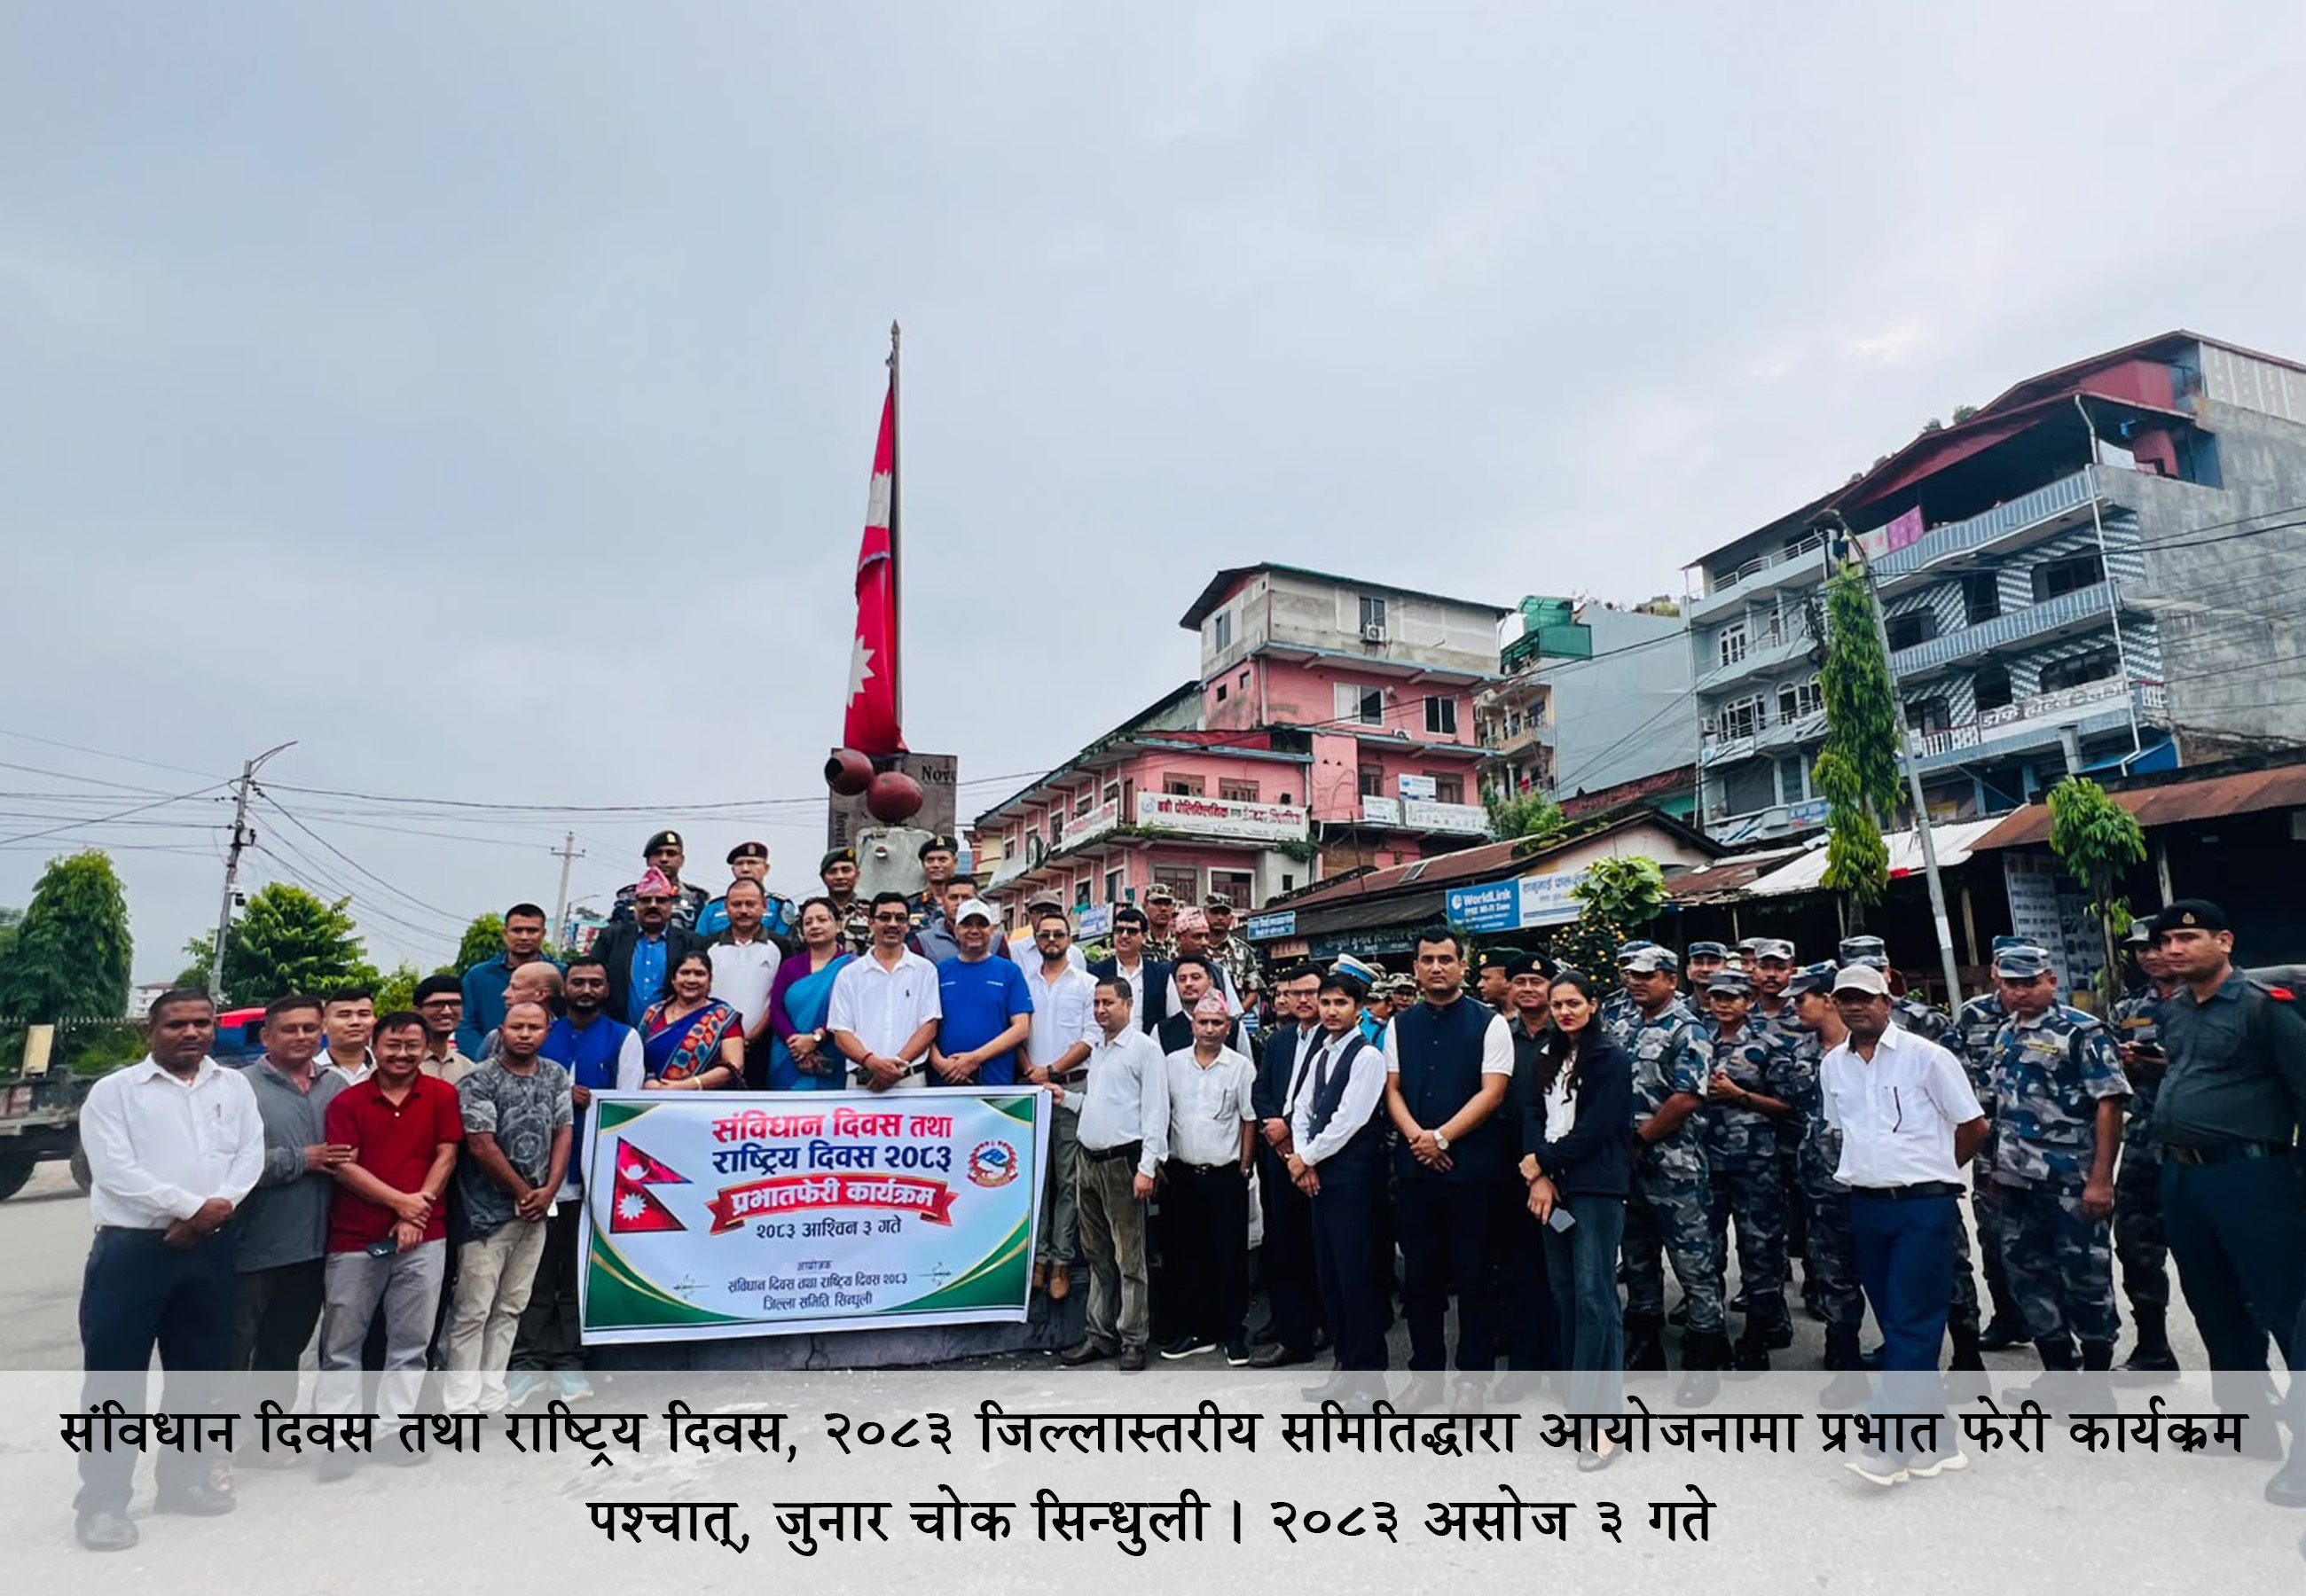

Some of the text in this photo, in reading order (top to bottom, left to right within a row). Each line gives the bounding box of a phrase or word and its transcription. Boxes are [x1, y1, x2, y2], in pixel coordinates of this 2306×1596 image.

[1463, 888, 1512, 906] WorldLink
[711, 1107, 953, 1143] संविधान दिवस तथा
[711, 1139, 953, 1175] राष्ट्रिय दिवस २०८३
[730, 1176, 937, 1216] प्रभातफेरी कार्यक्रम
[756, 1214, 903, 1240] २०८३ आश्विन ३ गते
[727, 1276, 765, 1293] संविधान
[768, 1275, 796, 1291] दिवस
[797, 1277, 818, 1290] तथा
[854, 1271, 881, 1287] दिवस
[882, 1271, 908, 1286] २०८३
[762, 1290, 874, 1311] जिल्ला समिति सिन्धुली
